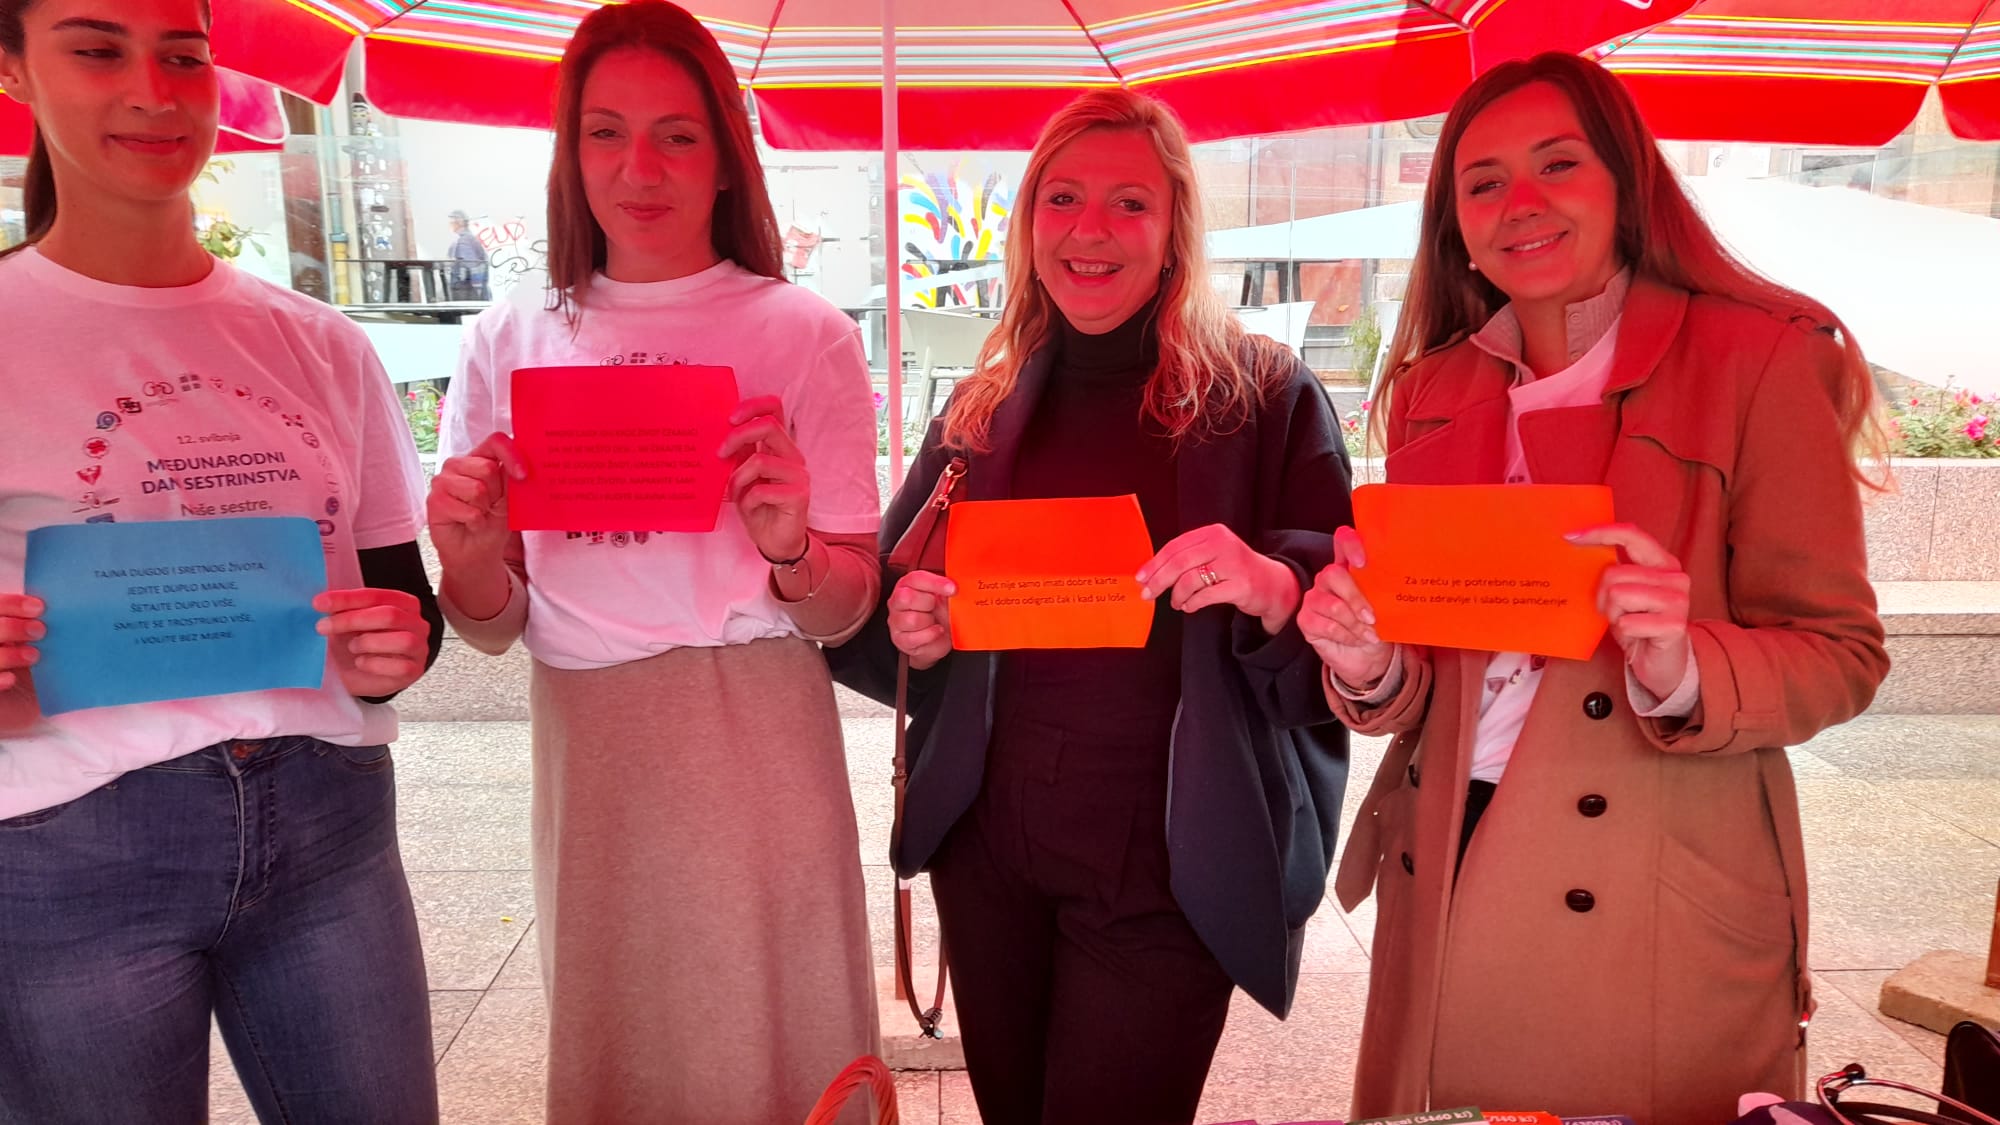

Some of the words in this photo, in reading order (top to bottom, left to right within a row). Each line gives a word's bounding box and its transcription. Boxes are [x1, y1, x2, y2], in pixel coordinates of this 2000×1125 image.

[176, 435, 196, 444] 12.
[198, 433, 241, 444] svibnja
[147, 451, 286, 473] MEĐUNARODNI
[141, 477, 182, 494] DAN
[184, 469, 302, 490] SESTRINSTVA
[180, 503, 216, 517] Naše
[221, 499, 273, 514] sestre,
[94, 568, 127, 578] TAJNA
[129, 566, 168, 577] DUGOG
[178, 563, 226, 575] SRETNOG
[127, 585, 160, 595] JEDITE
[163, 583, 198, 593] DUPLO
[978, 579, 999, 590] Život
[1001, 580, 1016, 591] nije
[1018, 580, 1041, 588] samo
[1042, 578, 1065, 588] imati
[1066, 576, 1093, 587] dobre
[1095, 576, 1118, 586] karte
[1405, 576, 1418, 585] Za
[1420, 576, 1449, 586] sreću
[1452, 576, 1462, 588] je
[1464, 577, 1517, 588] potrebno
[1519, 579, 1551, 588] samo
[130, 601, 171, 612] ŠETAJTE
[175, 600, 209, 610] DUPLO
[995, 596, 1020, 606] dobro
[1022, 595, 1055, 607] odigrati
[1057, 594, 1071, 604] čak
[1077, 593, 1094, 603] kad
[1096, 594, 1106, 602] su
[1107, 592, 1127, 602] loše
[1395, 592, 1426, 602] dobro
[1430, 593, 1472, 606] zdravlje
[1480, 595, 1510, 605] slabo
[1512, 596, 1568, 608] pamćenje
[152, 619, 164, 628] SE
[167, 615, 228, 626] TROSTRUKO
